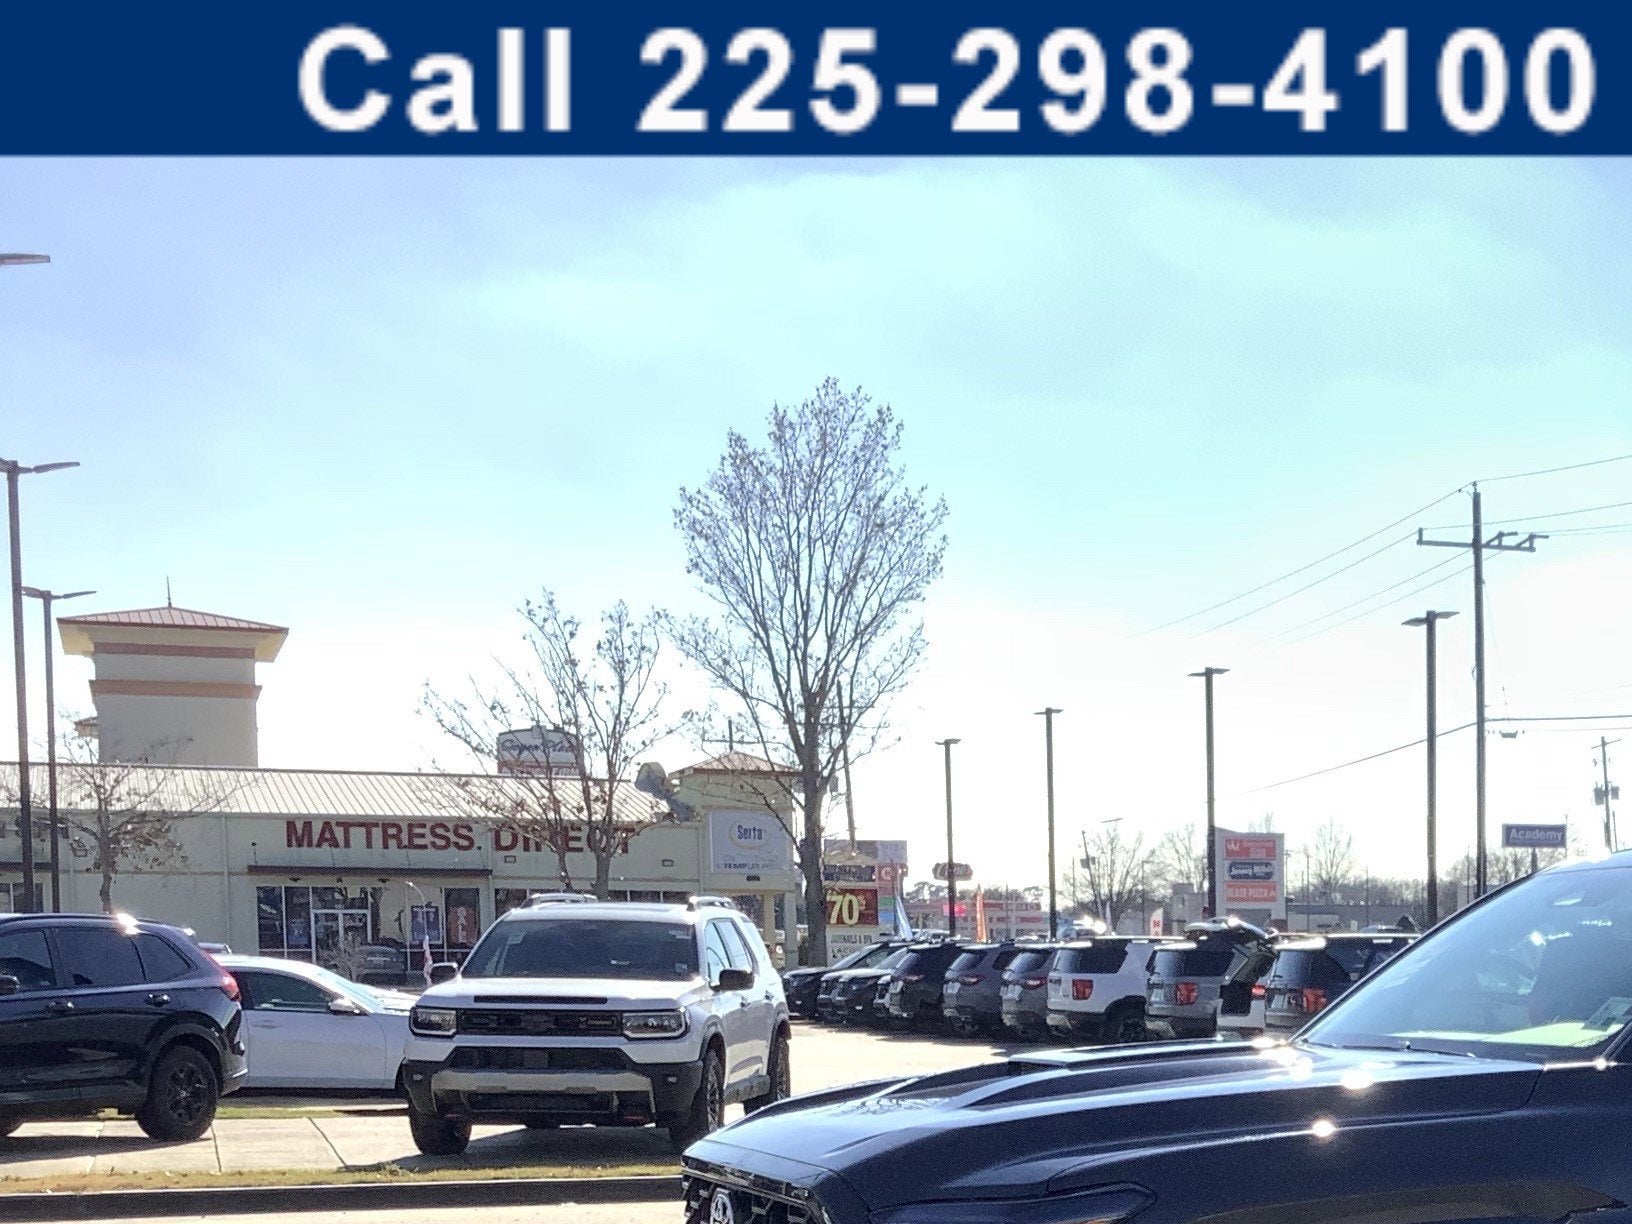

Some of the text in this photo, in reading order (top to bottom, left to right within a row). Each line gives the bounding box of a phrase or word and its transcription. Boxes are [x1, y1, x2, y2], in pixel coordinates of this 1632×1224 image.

[286, 819, 475, 850] MATTRESS
[737, 825, 763, 841] Serta
[1508, 828, 1564, 843] Academy
